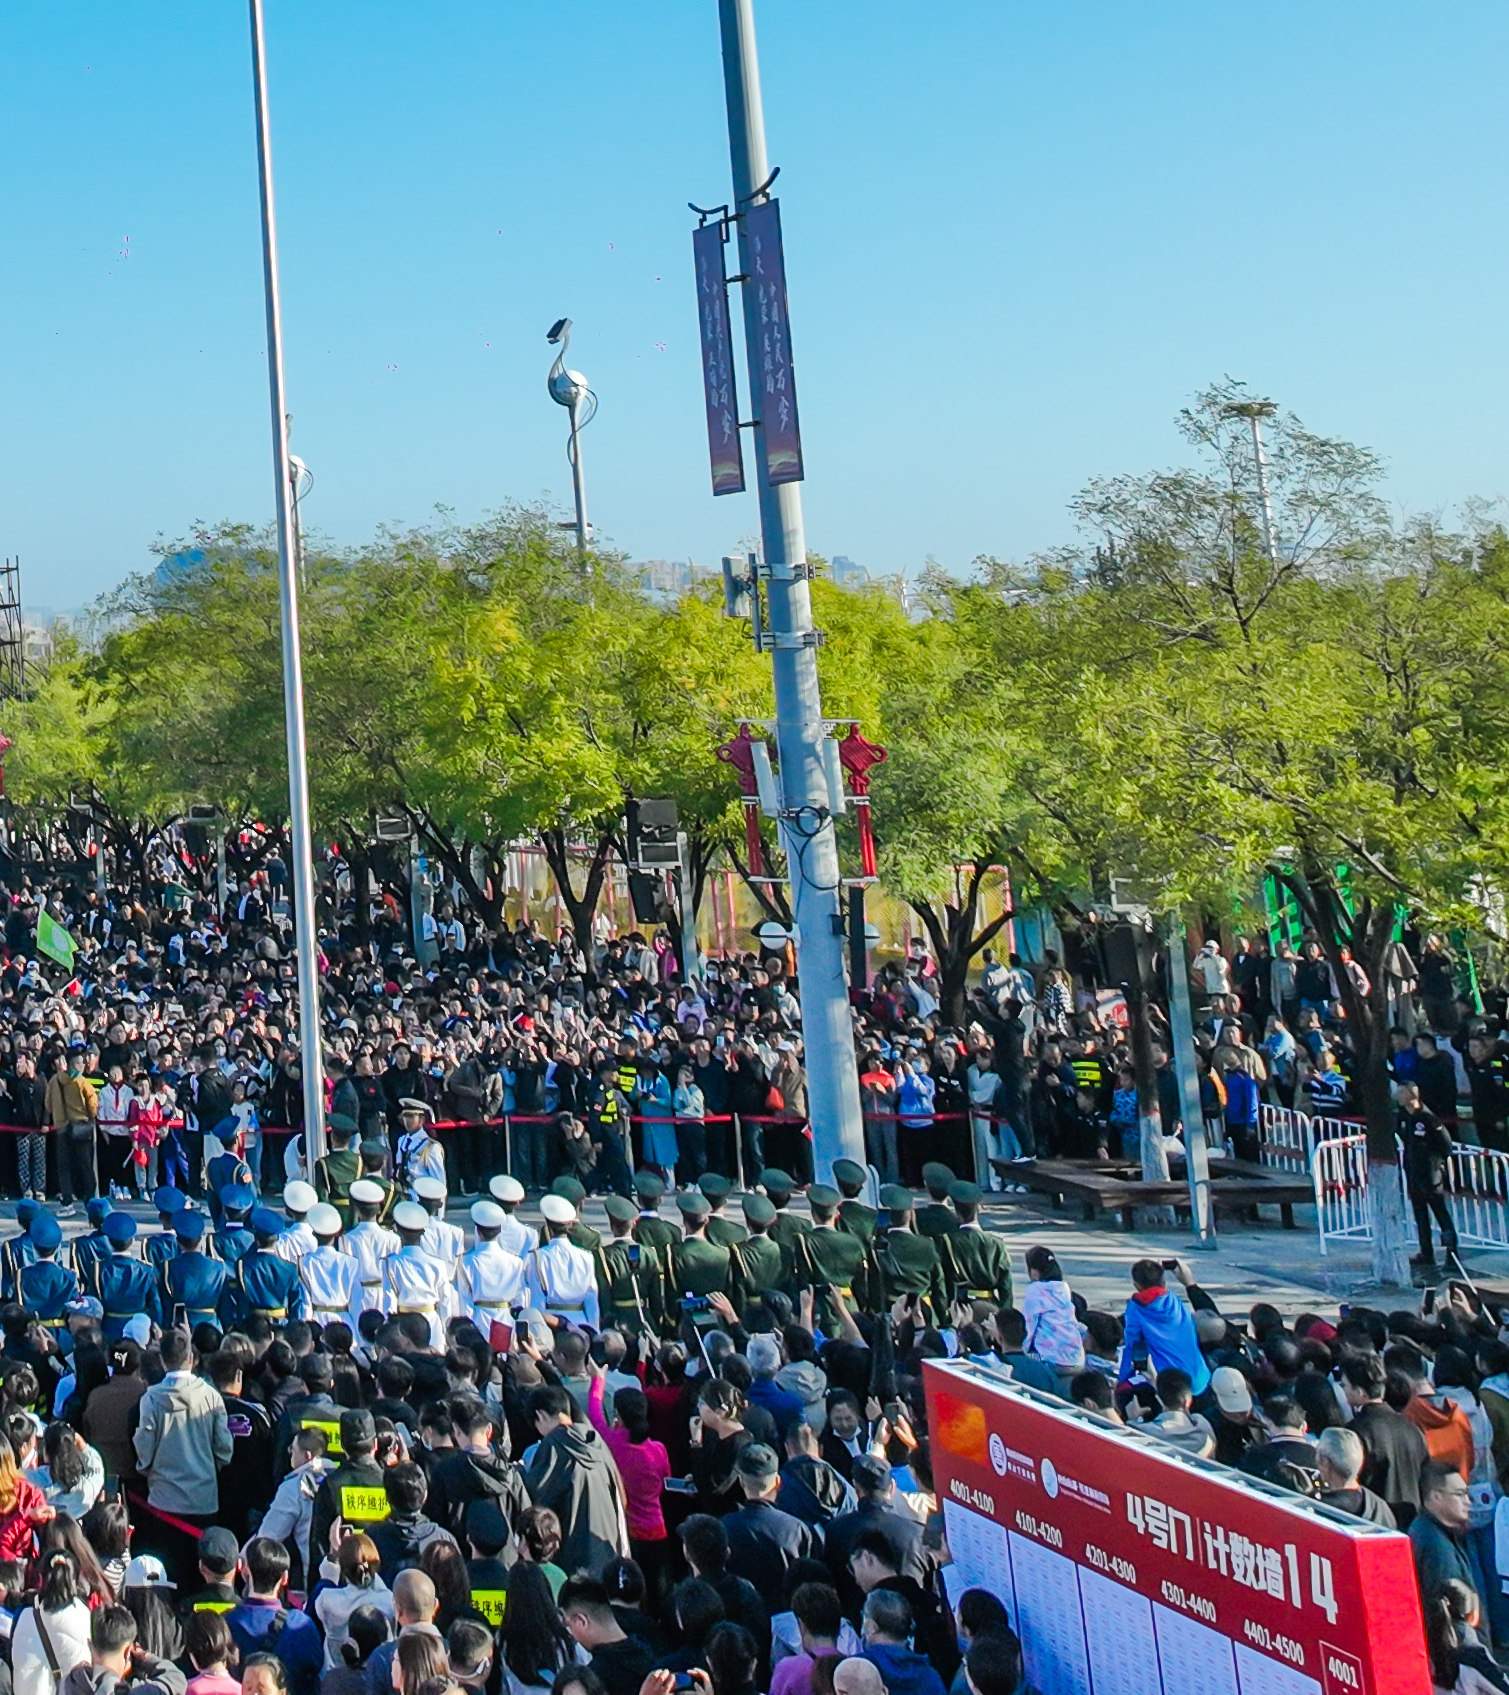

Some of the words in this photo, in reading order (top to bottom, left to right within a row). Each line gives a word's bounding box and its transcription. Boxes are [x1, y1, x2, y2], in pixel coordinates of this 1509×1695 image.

[950, 1478, 995, 1515] 4001-4100
[1015, 1509, 1063, 1548] 4101-4200
[1126, 1492, 1194, 1561] 4号门
[1085, 1543, 1136, 1584] 4201-4300
[1161, 1580, 1216, 1623] 4301-4400
[1243, 1618, 1304, 1665] 4401-4500
[1328, 1656, 1359, 1689] 4001
